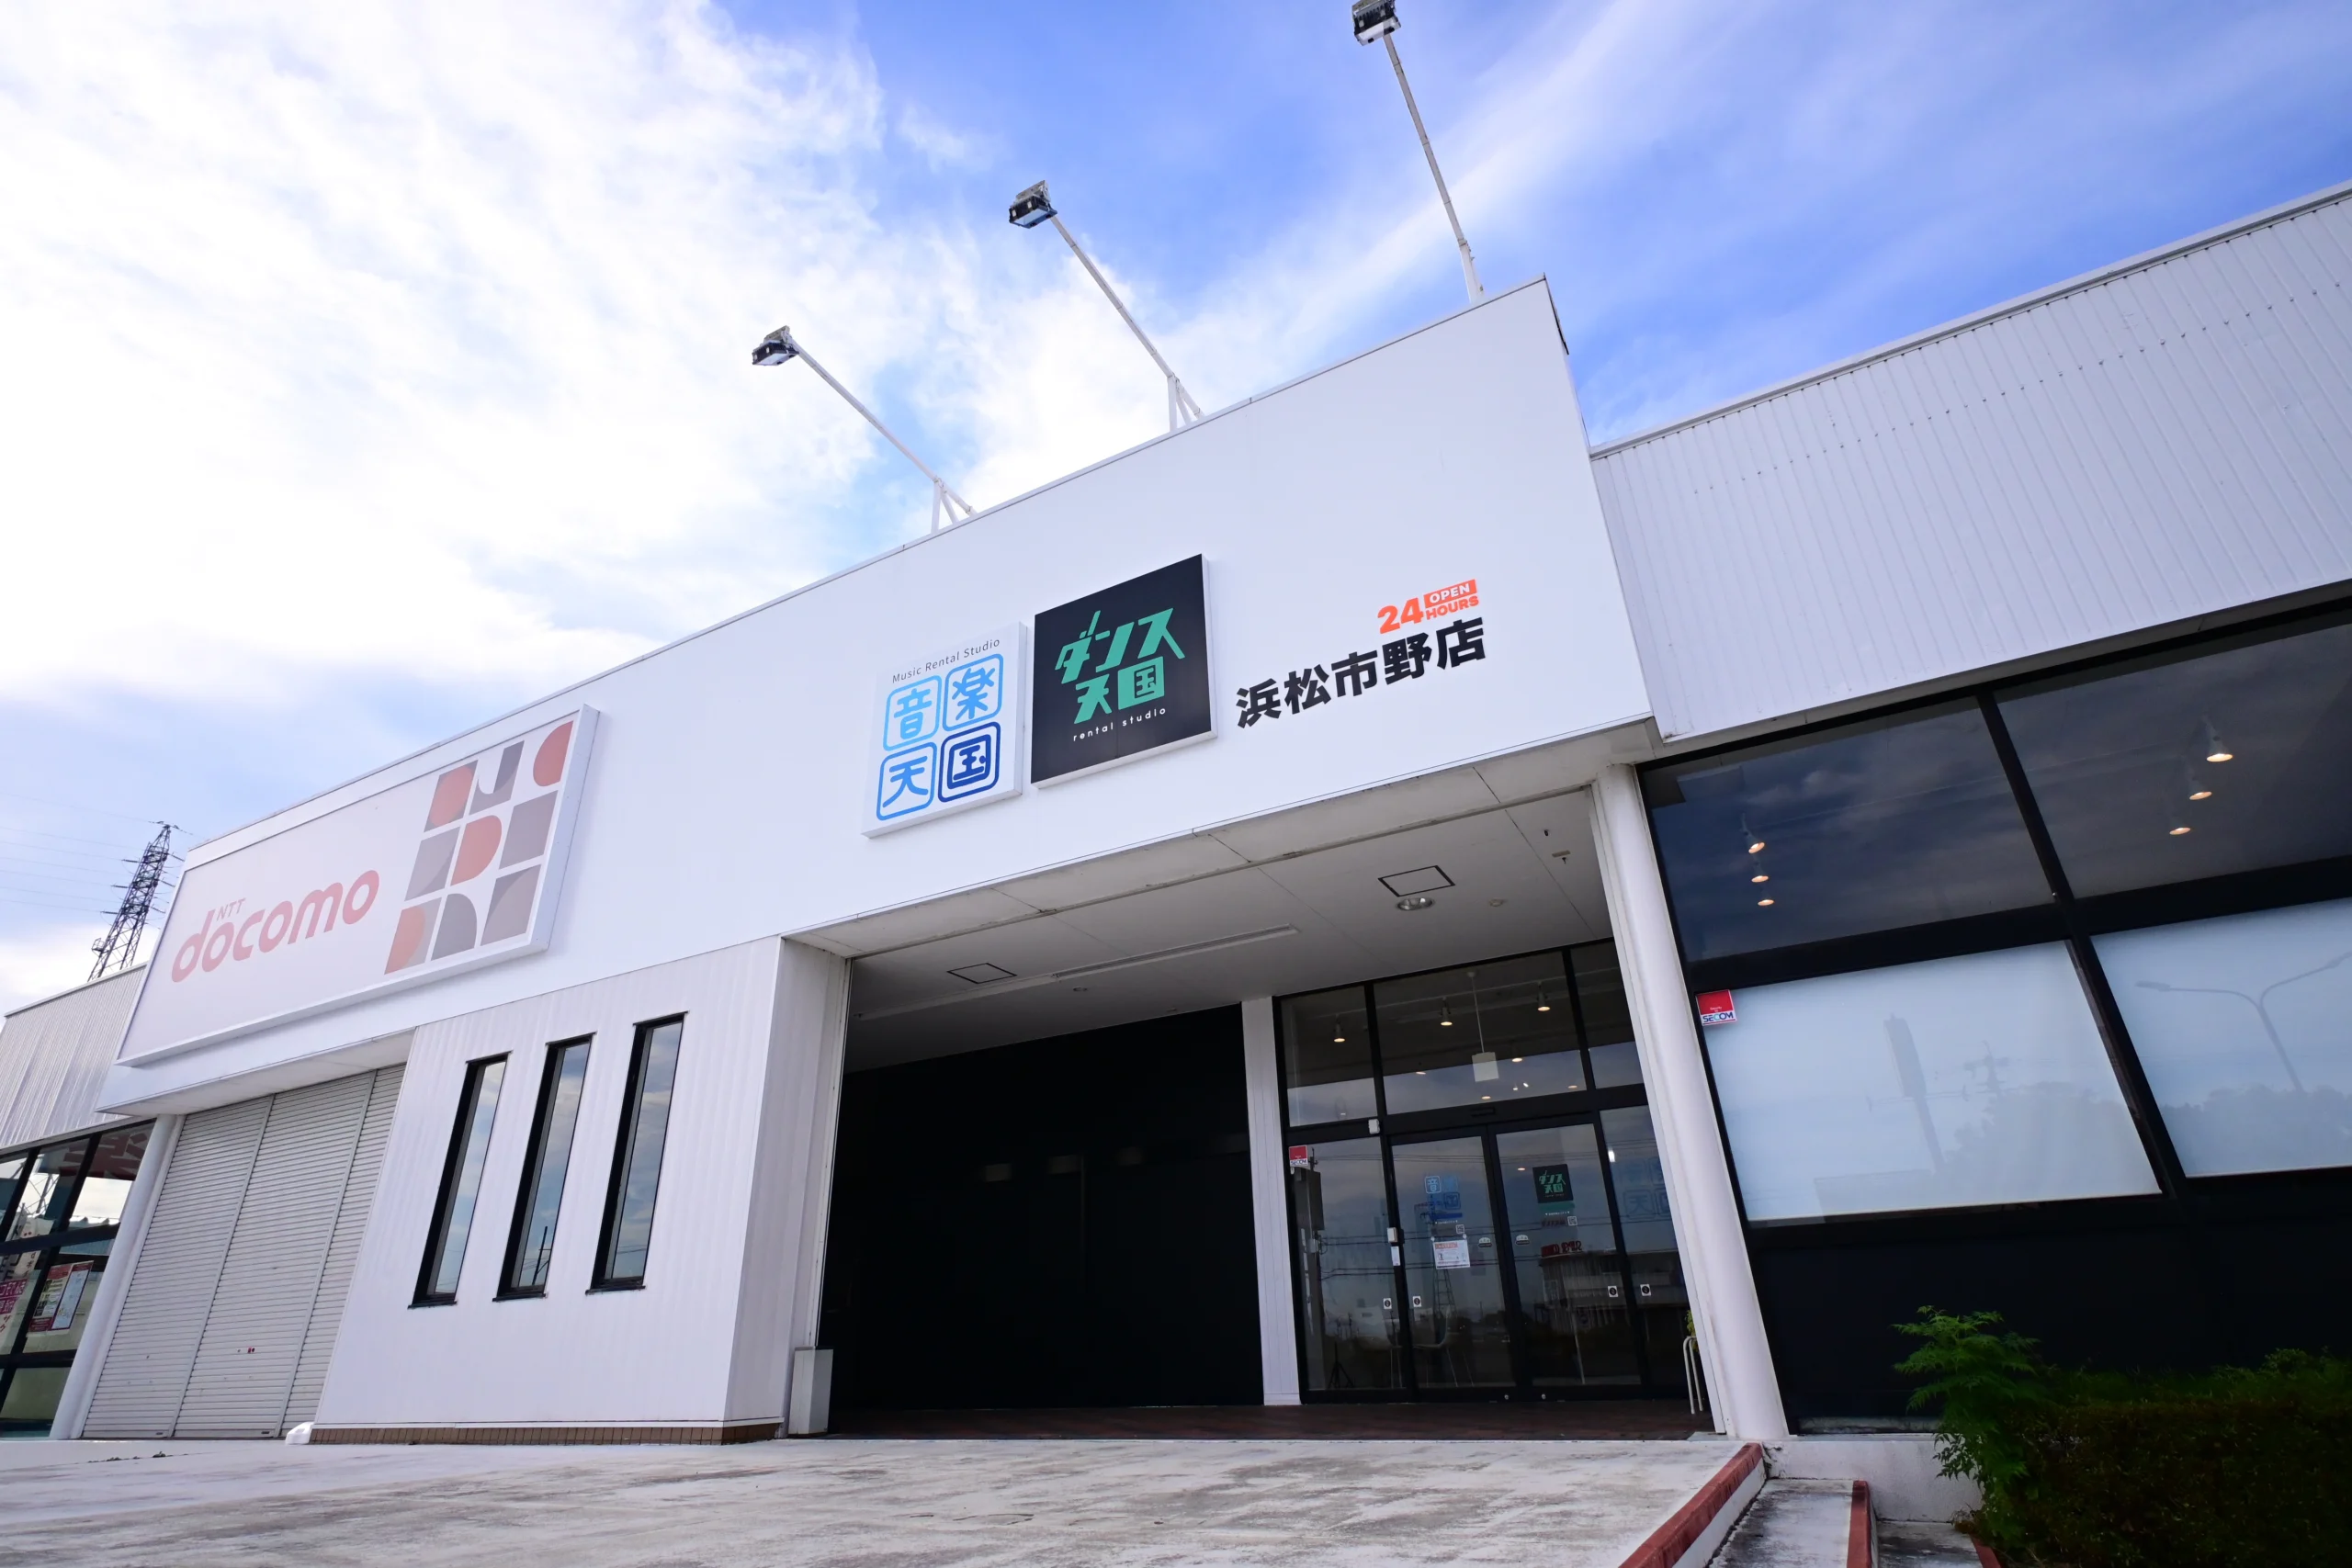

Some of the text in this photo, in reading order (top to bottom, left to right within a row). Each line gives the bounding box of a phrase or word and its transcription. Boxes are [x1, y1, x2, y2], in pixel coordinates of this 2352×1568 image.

[1426, 595, 1479, 621] HOURS
[1429, 582, 1471, 604] OPEN
[1377, 597, 1424, 634] 24
[892, 639, 1001, 683] Music Rental Studio
[1055, 610, 1185, 684] ダンス
[1073, 656, 1165, 724] 天国
[1236, 616, 1486, 728] 浜松市野店
[894, 667, 995, 739] 音楽
[1073, 708, 1166, 741] rental studio
[883, 734, 992, 808] 天国
[171, 870, 380, 983] docomo
[217, 897, 246, 921] NTT
[1702, 1011, 1734, 1022] SECOM
